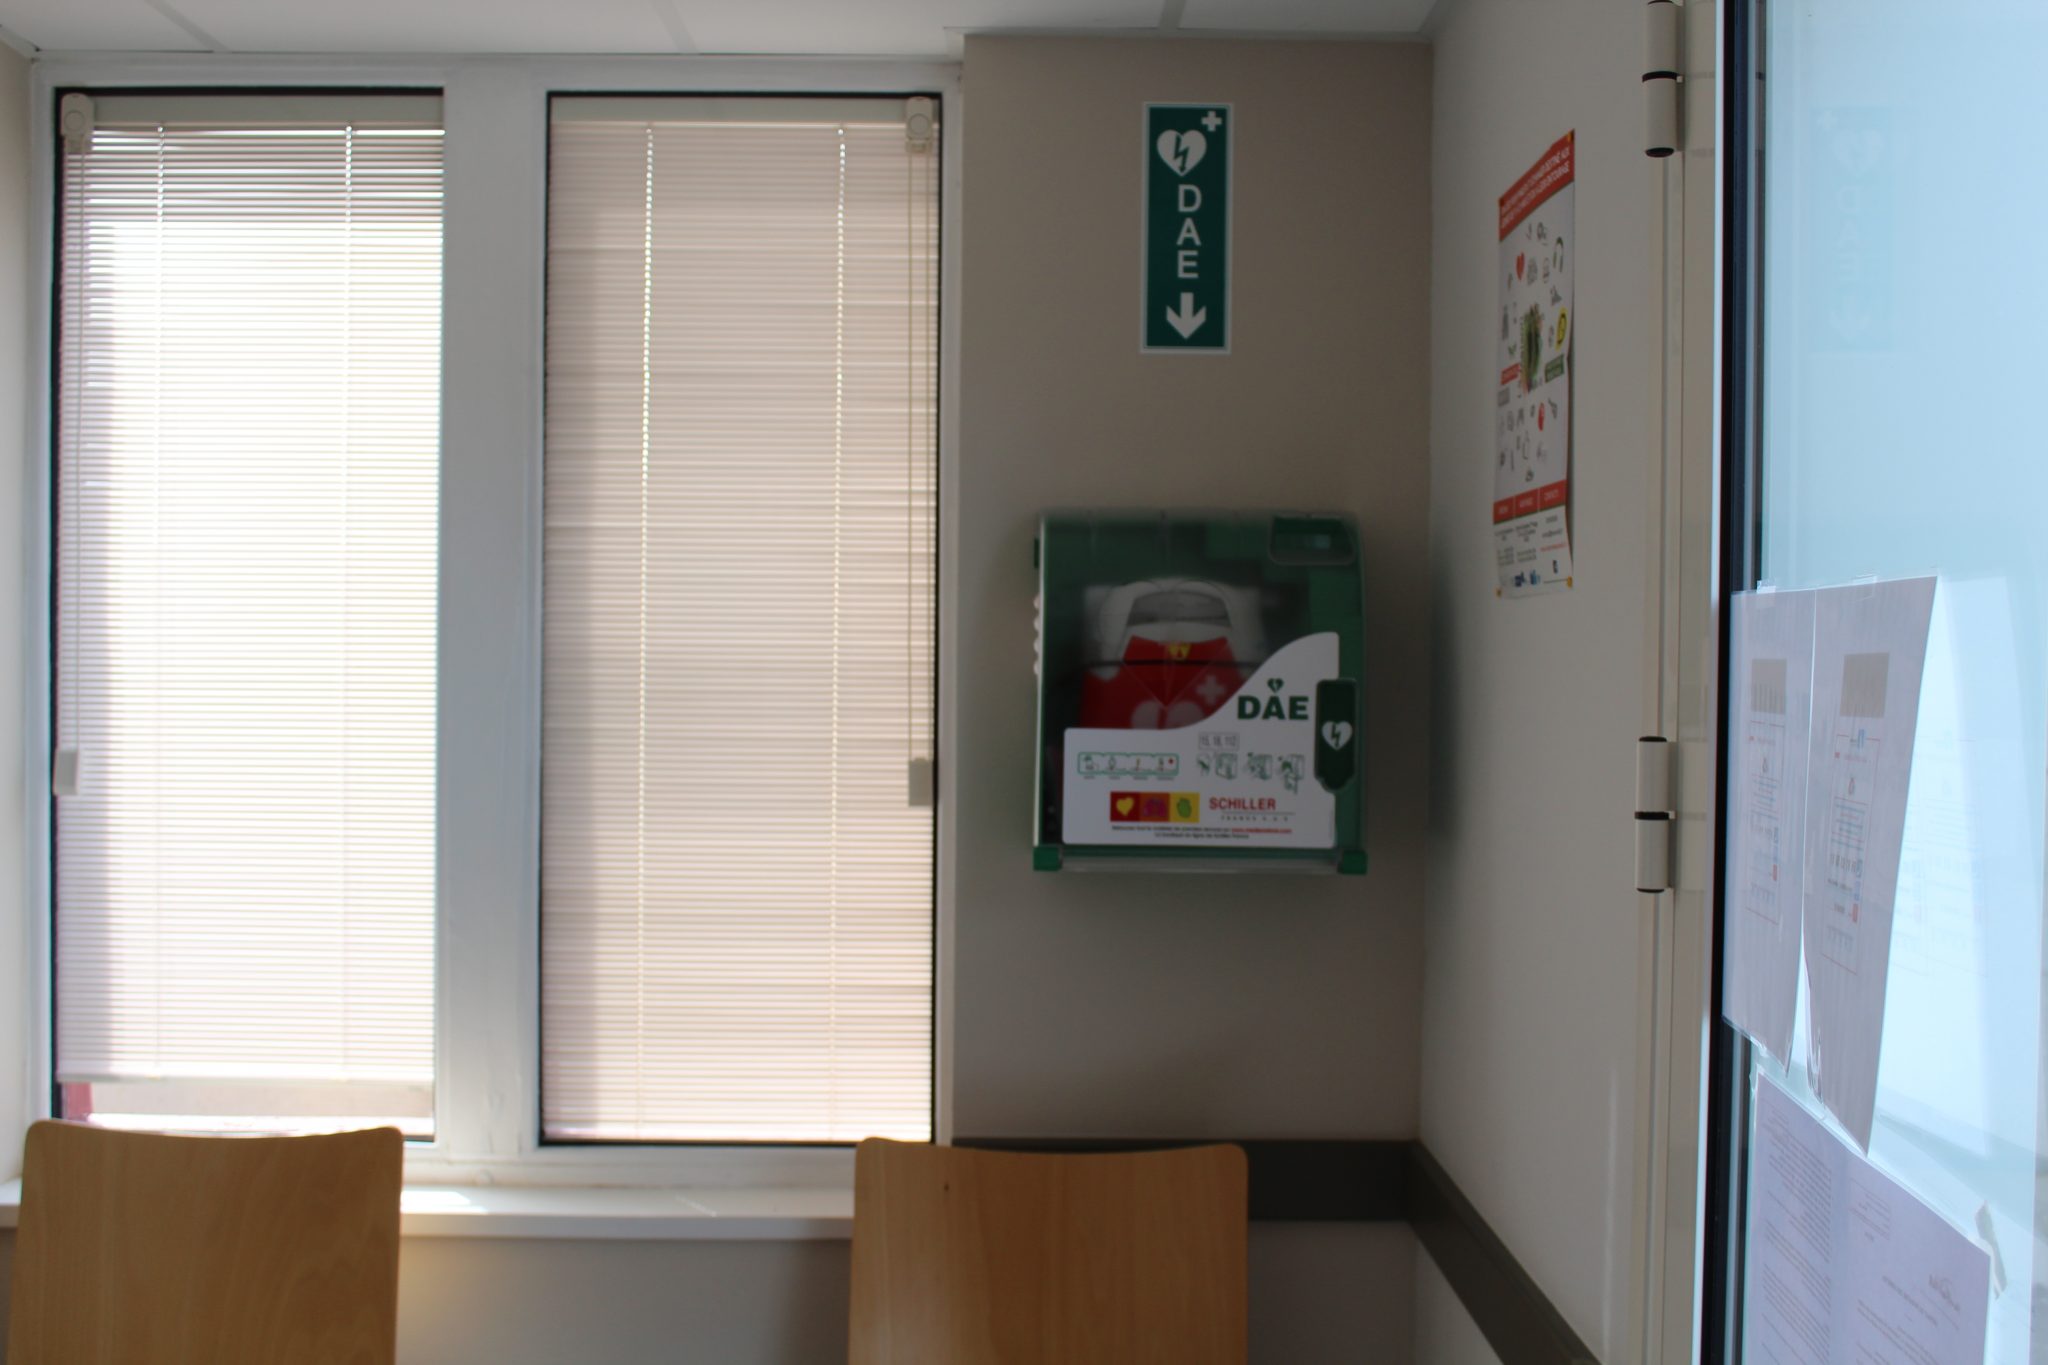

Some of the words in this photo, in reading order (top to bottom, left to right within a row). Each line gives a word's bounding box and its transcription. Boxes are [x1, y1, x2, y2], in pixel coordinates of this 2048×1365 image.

[1176, 183, 1203, 280] DAE
[1237, 695, 1309, 720] DAE
[1209, 798, 1276, 811] SCHILLER
